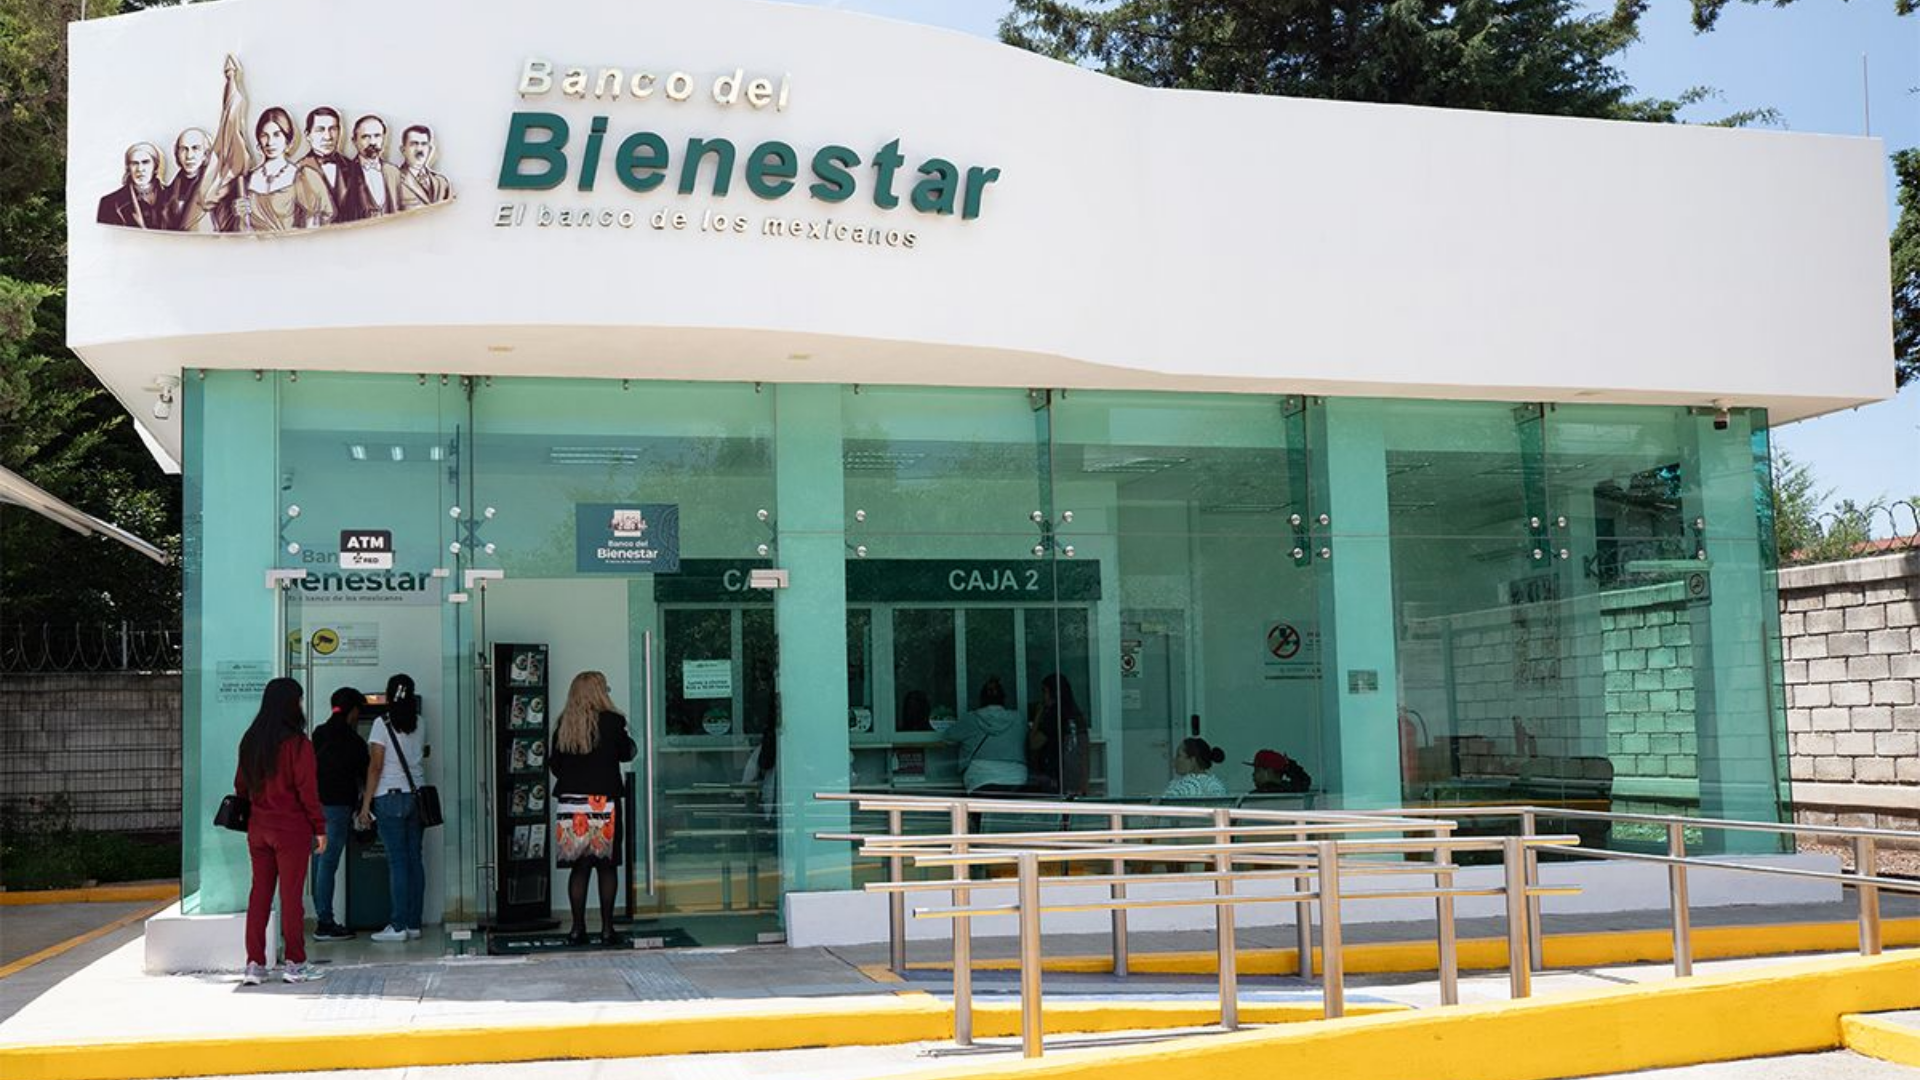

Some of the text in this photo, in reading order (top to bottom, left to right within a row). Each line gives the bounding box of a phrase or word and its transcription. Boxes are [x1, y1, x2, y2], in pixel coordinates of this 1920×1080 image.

[518, 57, 791, 112] Banco del
[497, 110, 1001, 221] Bienestar
[495, 202, 917, 248] El banco de los mexicanos
[346, 536, 385, 549] ATM
[597, 547, 659, 559] Bienestar
[607, 539, 649, 548] Banco del
[302, 549, 342, 564] Ban
[286, 569, 430, 592] enestar
[949, 569, 1039, 591] CAJA 2
